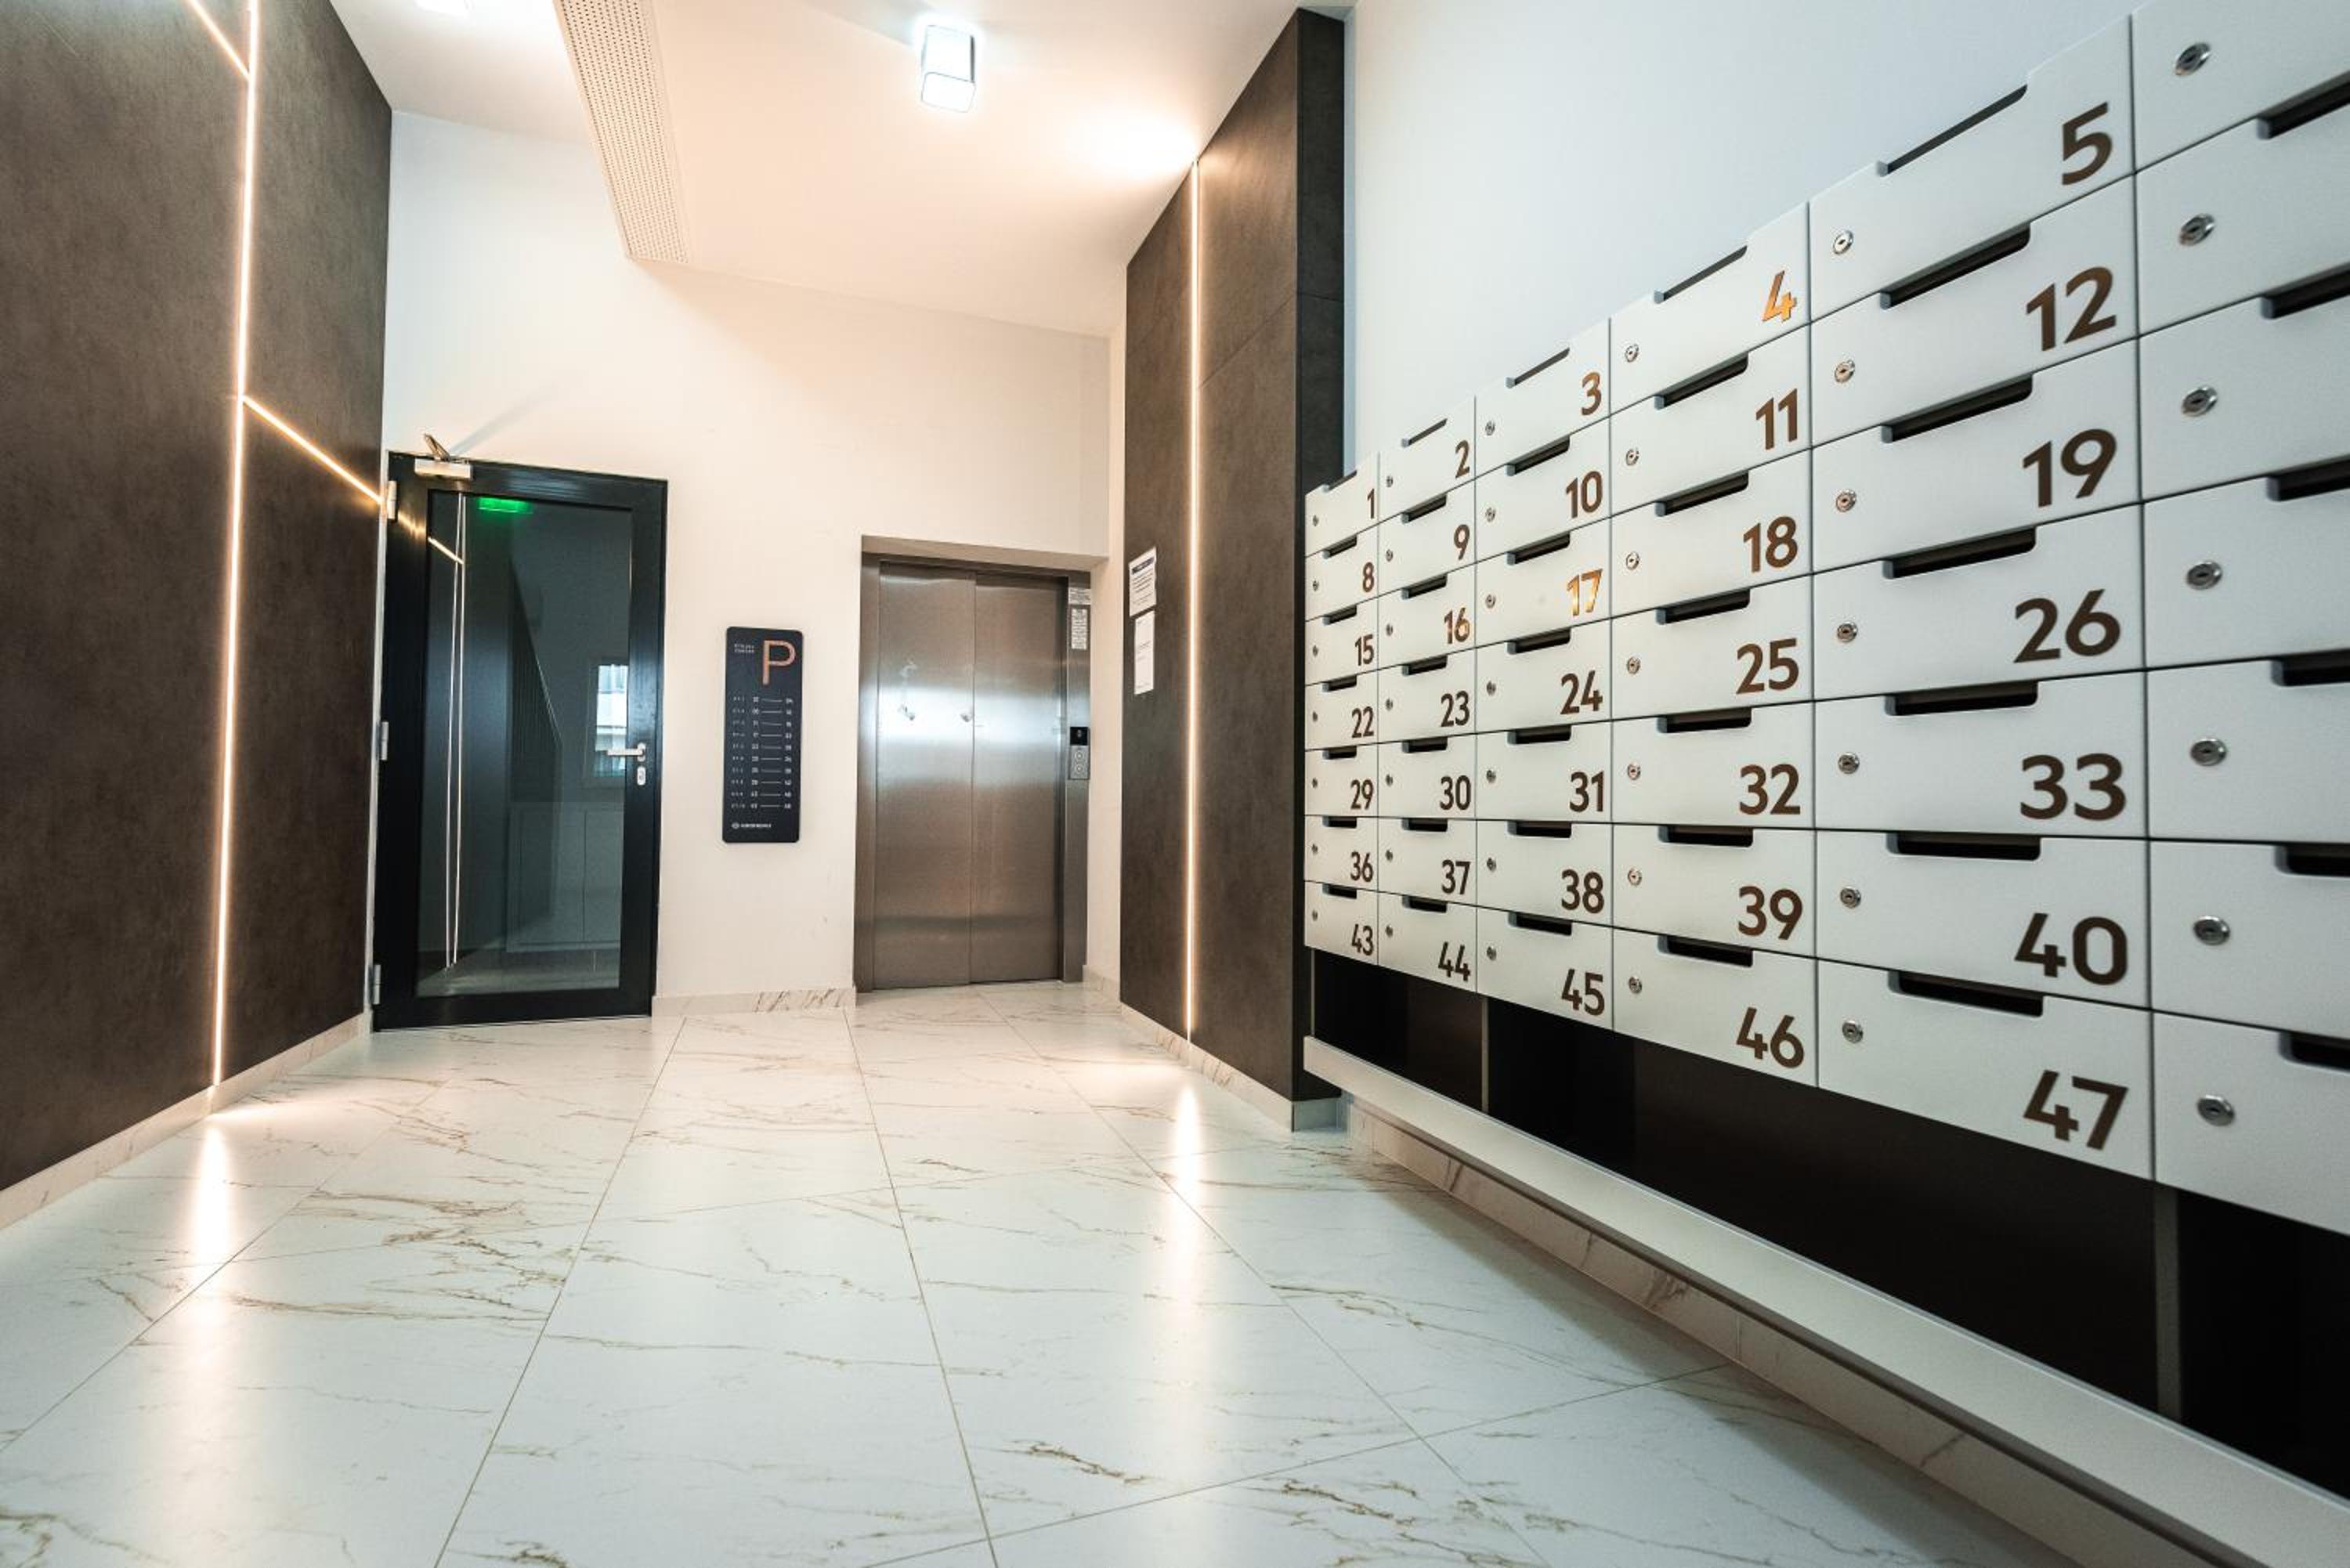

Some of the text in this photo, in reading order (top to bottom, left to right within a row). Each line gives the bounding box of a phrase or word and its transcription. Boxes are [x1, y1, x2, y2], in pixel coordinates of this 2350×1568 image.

[2062, 102, 2113, 186] 5
[1762, 270, 1797, 323] 4
[2026, 266, 2117, 351] 12
[1582, 372, 1601, 416] 3
[1756, 388, 1798, 450] 11
[1455, 440, 1470, 479] 2
[2023, 428, 2117, 508] 19
[1368, 489, 1375, 519] 1
[1566, 471, 1603, 518] 10
[1454, 524, 1470, 560] 9
[1744, 516, 1799, 573] 18
[1362, 562, 1374, 593] 8
[1567, 569, 1603, 616] 17
[1444, 608, 1470, 645] 16
[2013, 589, 2121, 663] 26
[762, 639, 797, 686] P
[1355, 634, 1375, 666] 15
[1736, 638, 1799, 695] 25
[1440, 691, 1470, 728] 23
[1560, 670, 1603, 715] 24
[1351, 706, 1374, 739] 22
[1350, 779, 1374, 810] 29
[1440, 775, 1471, 811] 30
[1570, 771, 1604, 813] 31
[1739, 764, 1801, 815] 32
[2020, 753, 2127, 821] 33
[1350, 851, 1374, 883] 36
[1441, 859, 1471, 895] 37
[1561, 869, 1604, 914] 38
[1738, 886, 1803, 940] 39
[1351, 924, 1374, 956] 43
[1438, 941, 1471, 982] 44
[2014, 912, 2128, 985] 40
[1561, 968, 1604, 1017] 45
[1736, 1007, 1805, 1068] 46
[2023, 1070, 2129, 1151] 47
